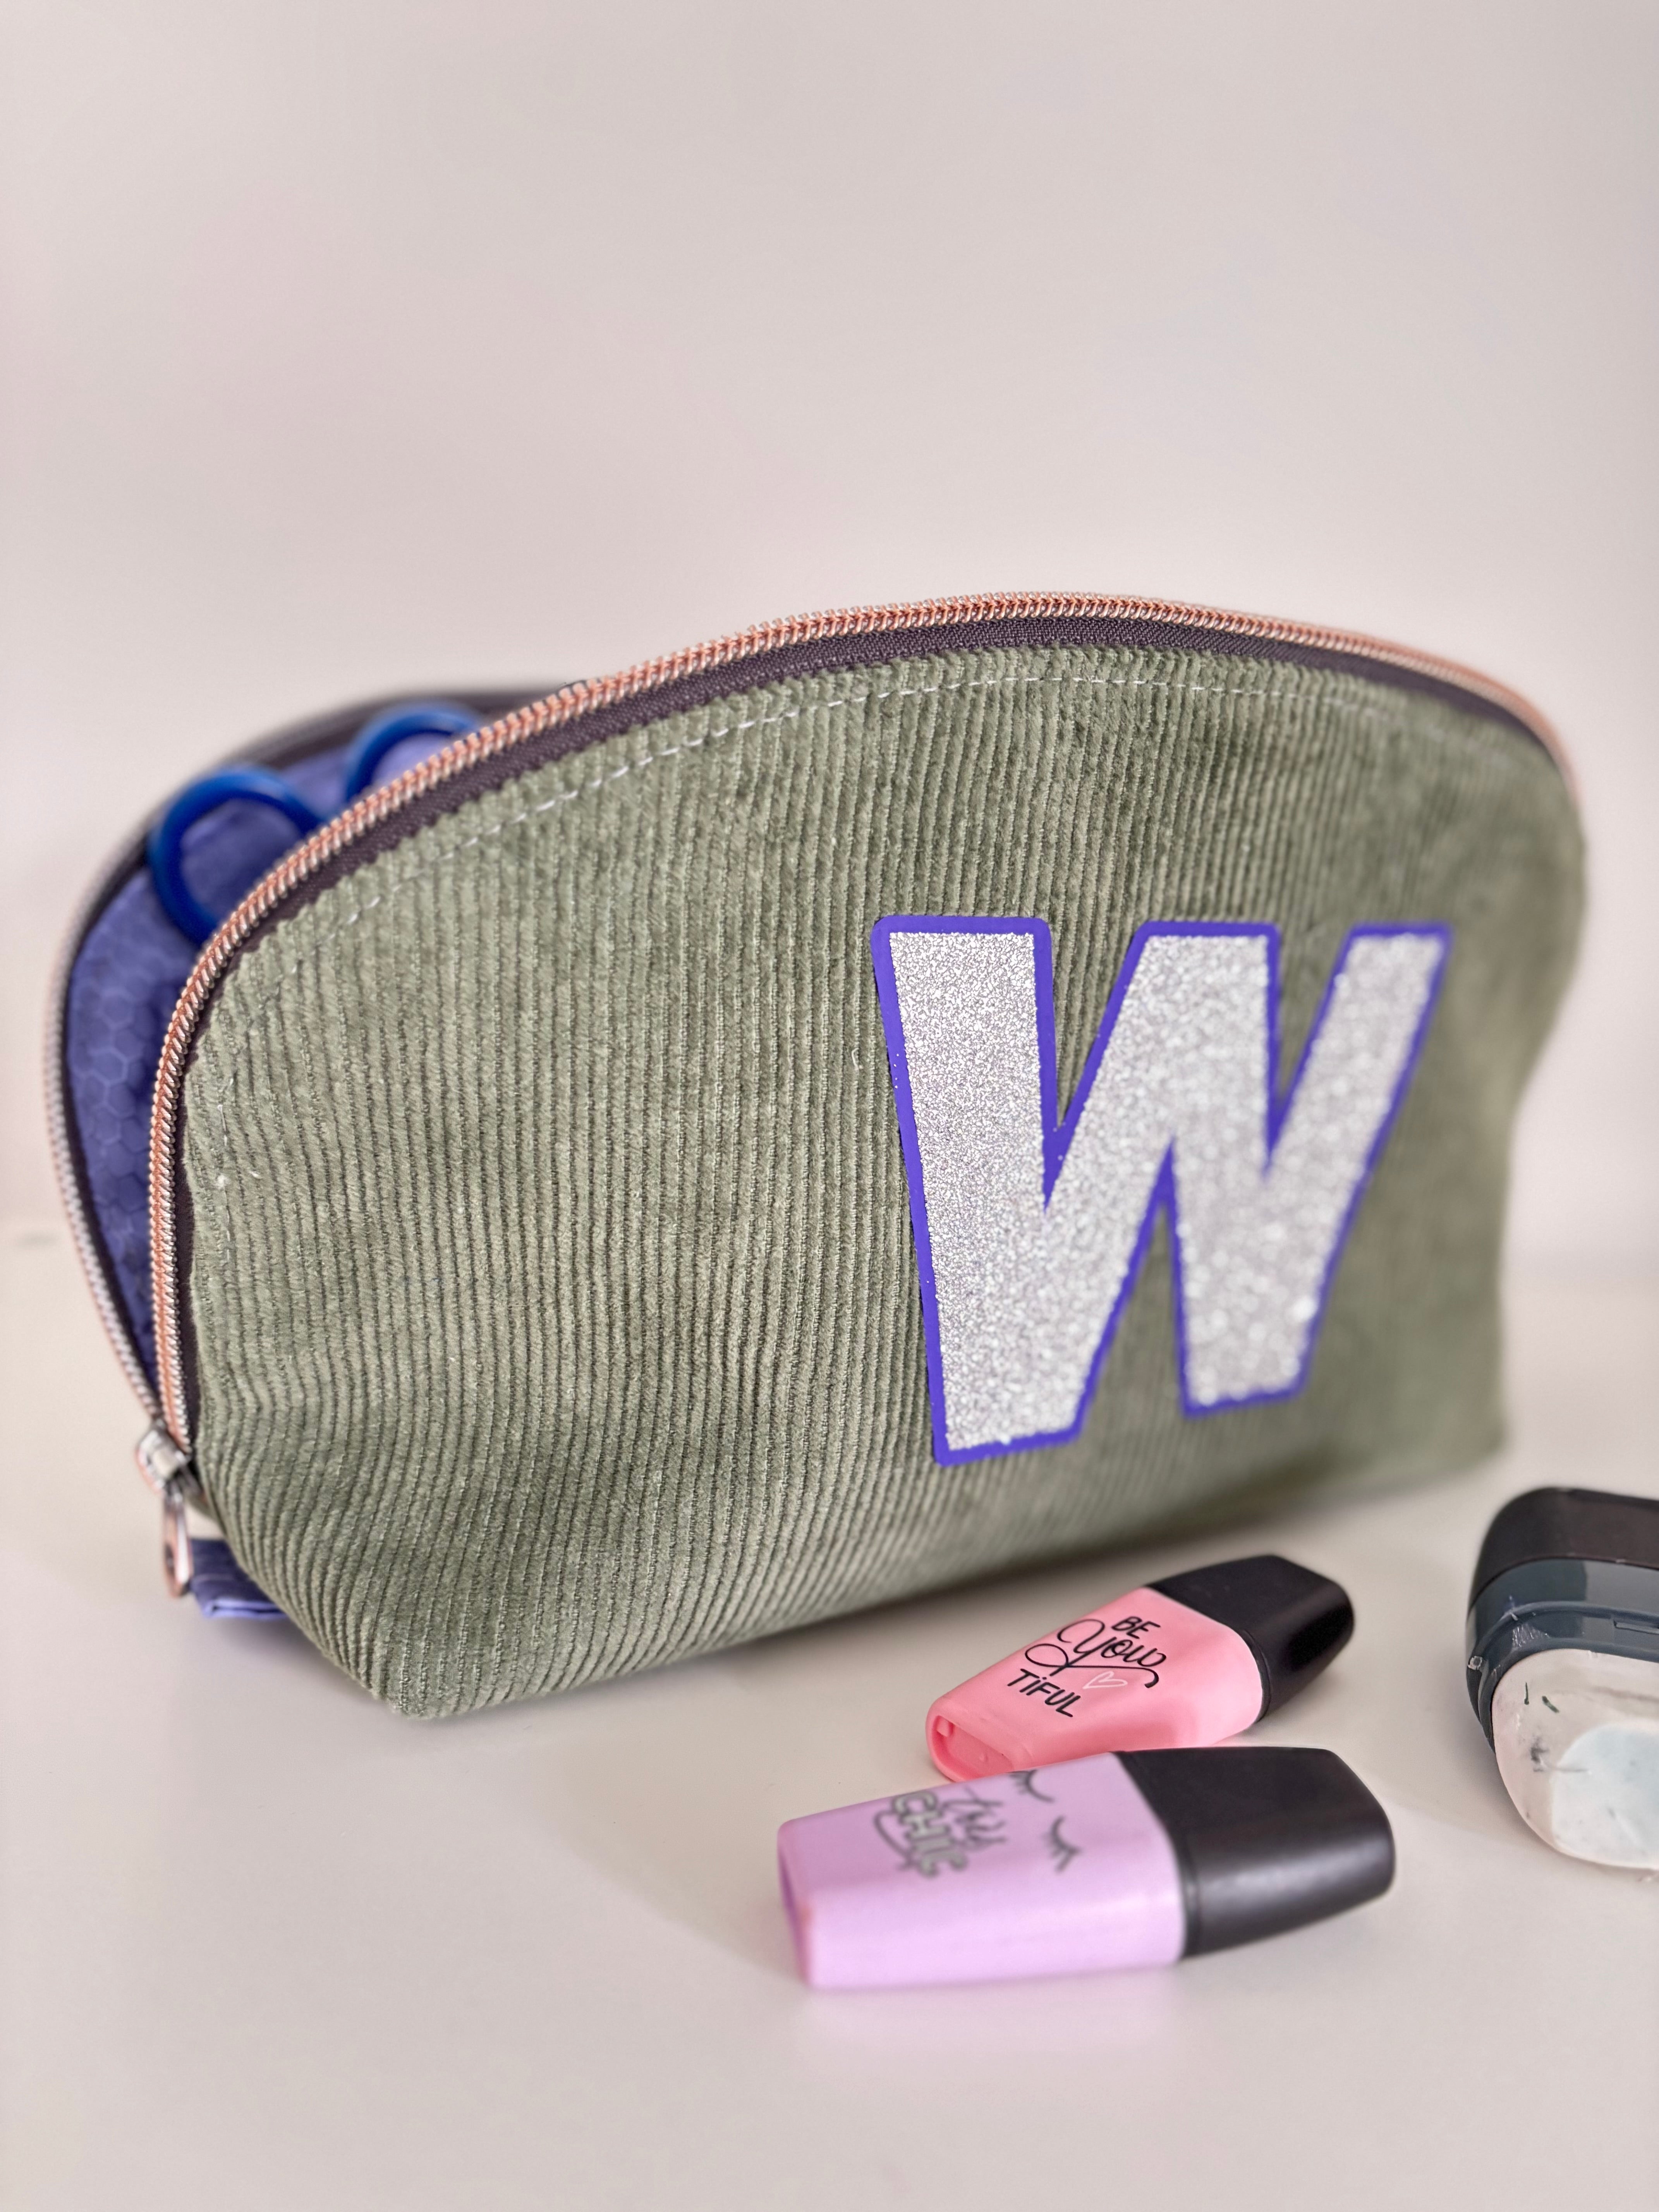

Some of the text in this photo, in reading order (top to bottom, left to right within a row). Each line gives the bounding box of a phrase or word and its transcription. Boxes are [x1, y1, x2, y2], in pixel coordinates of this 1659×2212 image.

[870, 914, 1451, 1468] W
[1111, 1616, 1161, 1640] BE
[892, 1791, 969, 1878] CHIC
